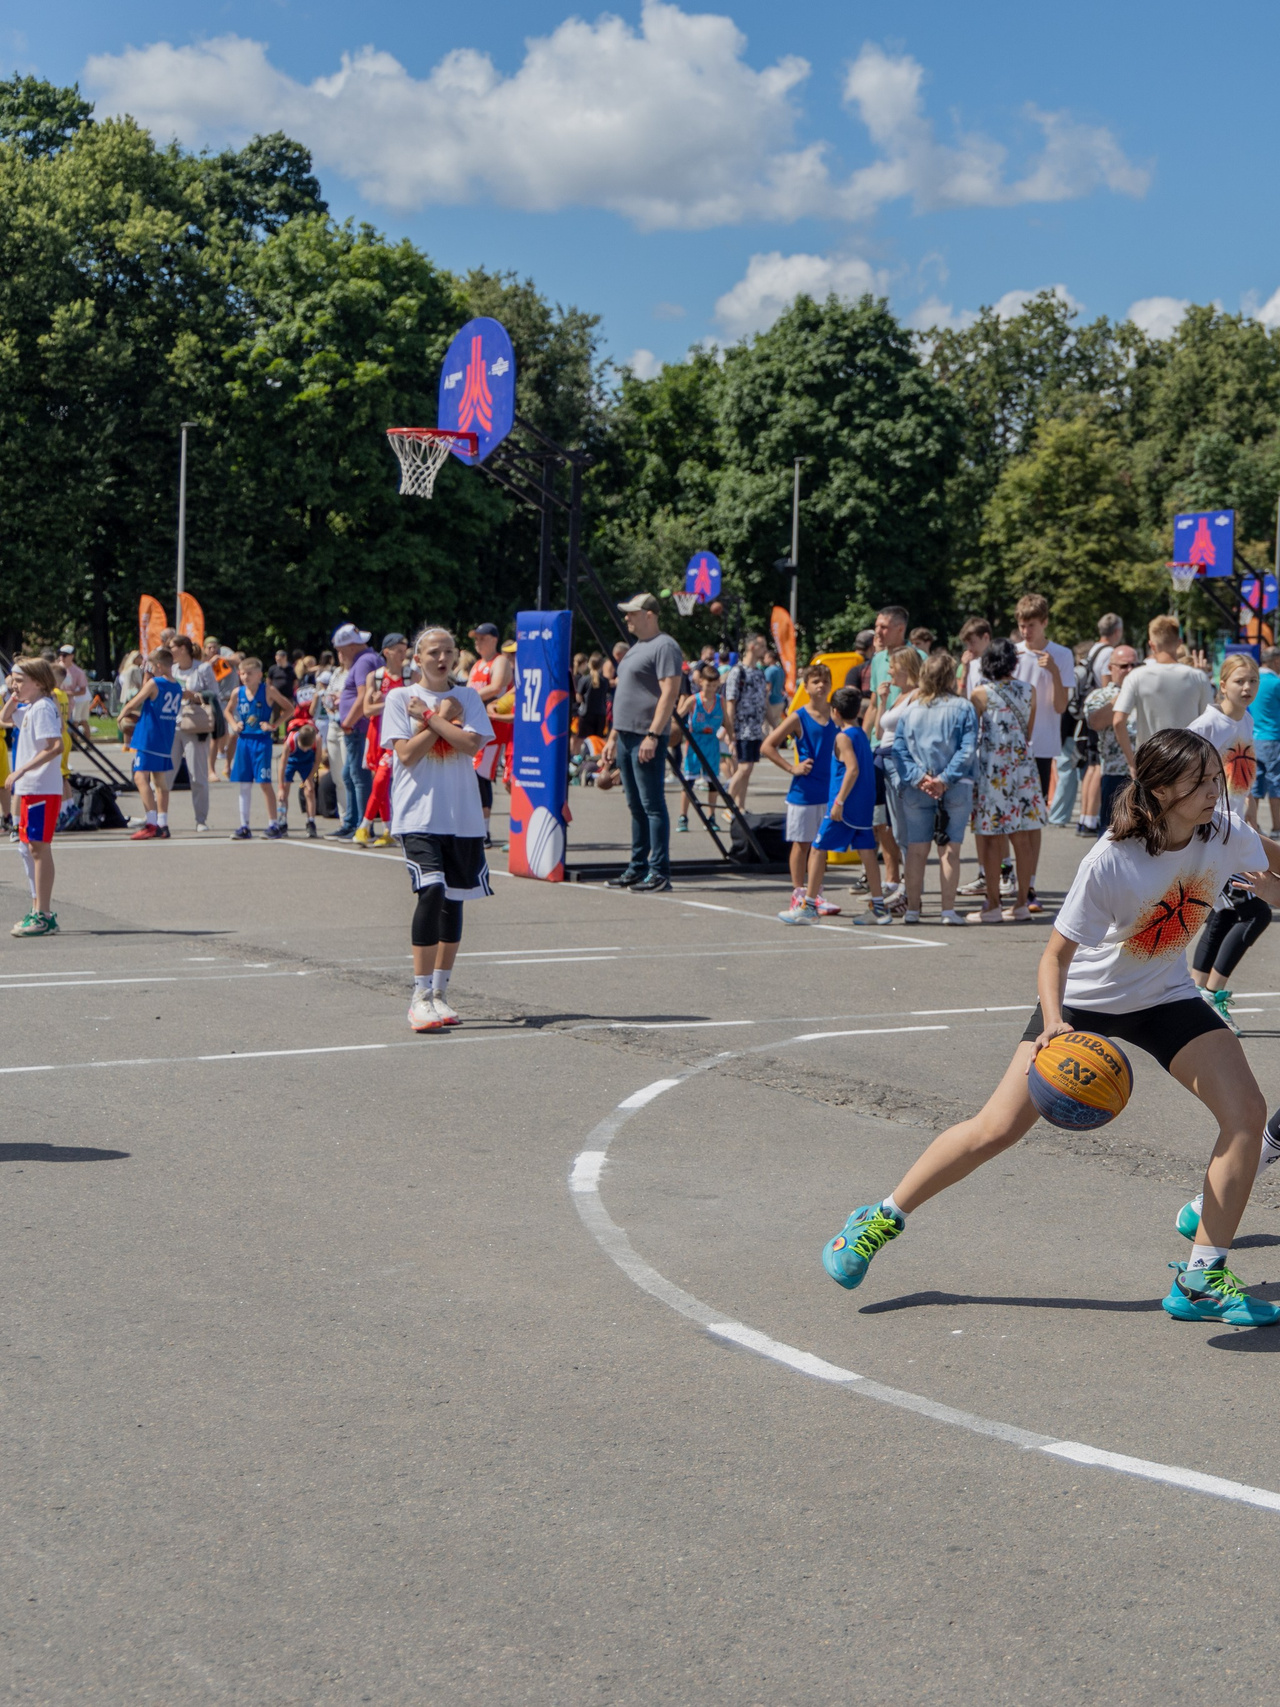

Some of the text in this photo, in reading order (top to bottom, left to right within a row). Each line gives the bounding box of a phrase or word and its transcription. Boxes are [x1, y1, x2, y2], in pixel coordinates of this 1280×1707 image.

[162, 691, 180, 714] 24
[522, 669, 541, 722] 32
[1064, 1034, 1122, 1077] Wilson
